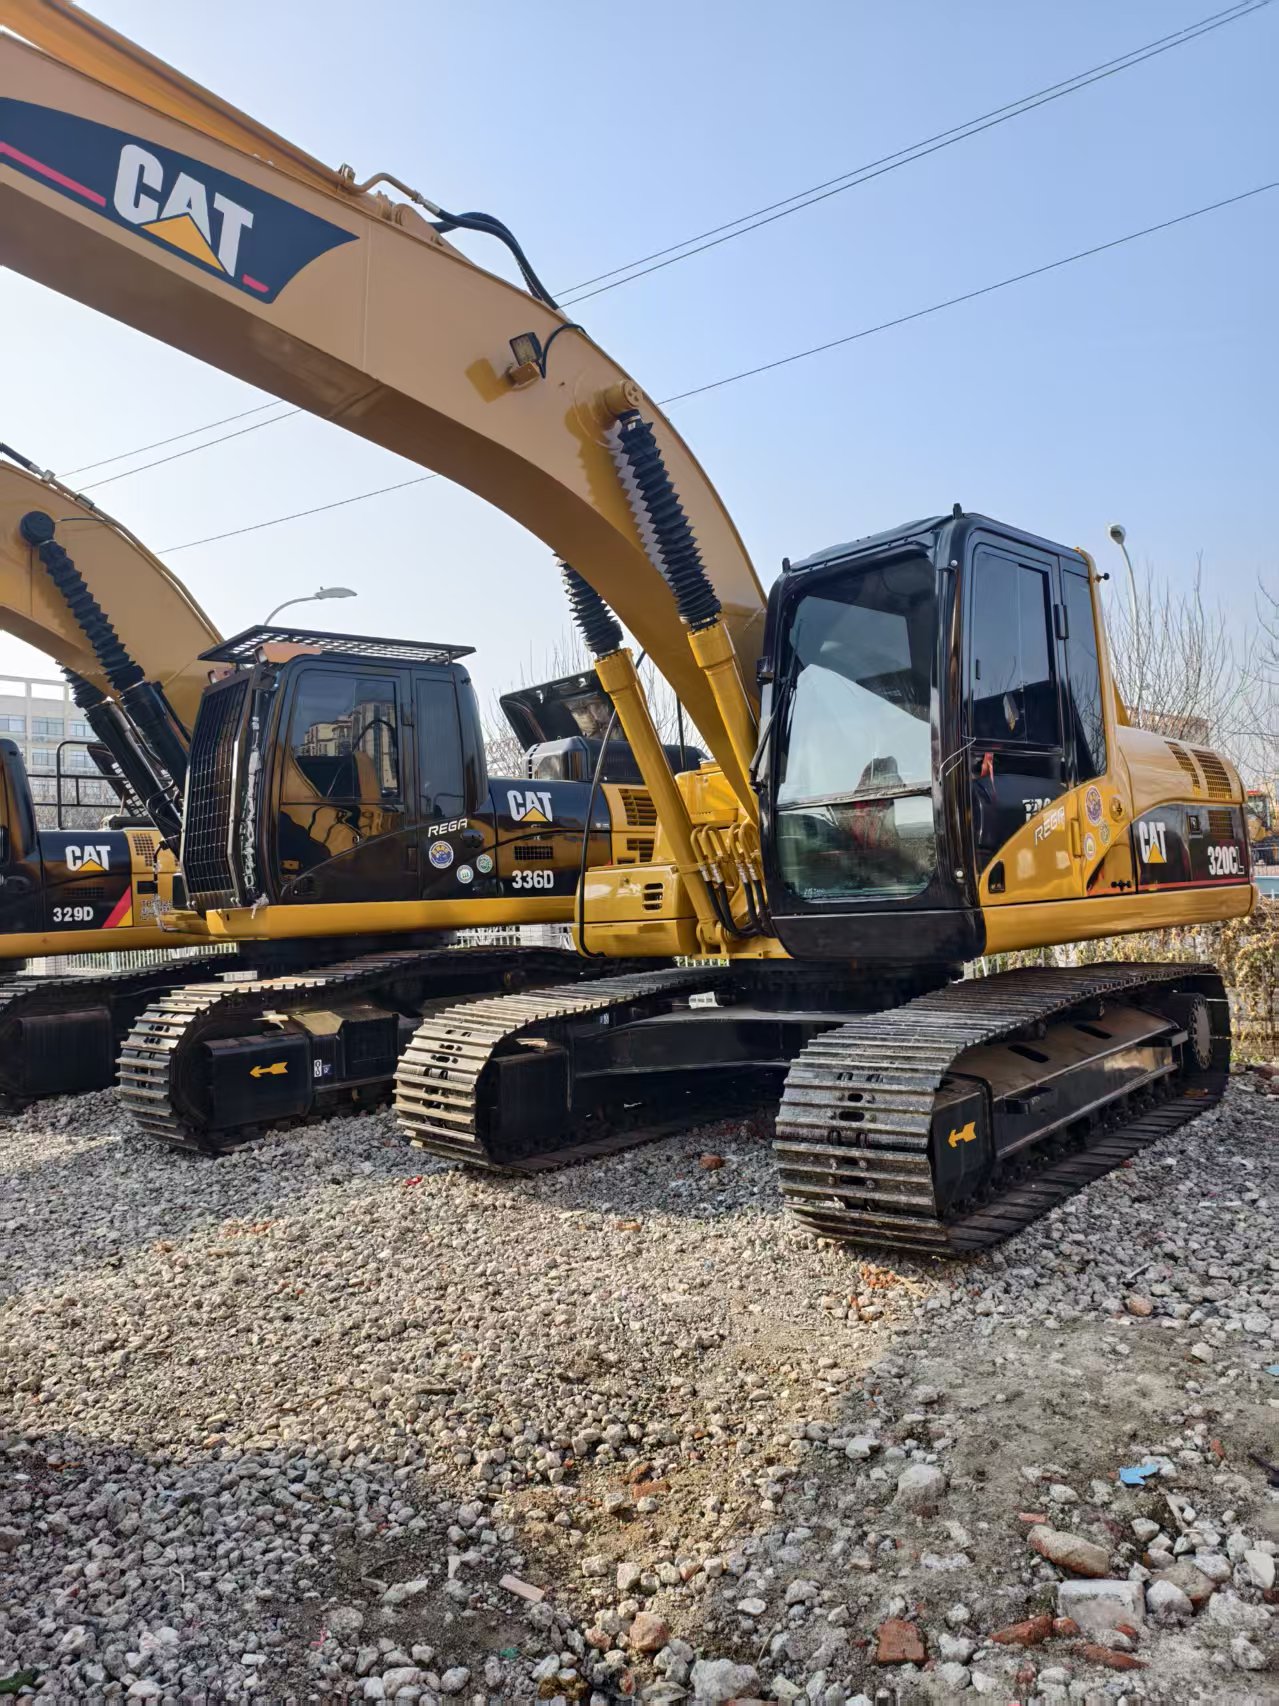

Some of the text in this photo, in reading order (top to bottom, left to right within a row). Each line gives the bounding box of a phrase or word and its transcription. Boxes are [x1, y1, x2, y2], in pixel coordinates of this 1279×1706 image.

[113, 143, 254, 277] CAT
[507, 790, 553, 822] CAT
[428, 818, 468, 837] REGA
[1139, 821, 1167, 863] CAT
[65, 845, 111, 871] CAT
[512, 870, 554, 889] 336D
[53, 907, 94, 922] 329D
